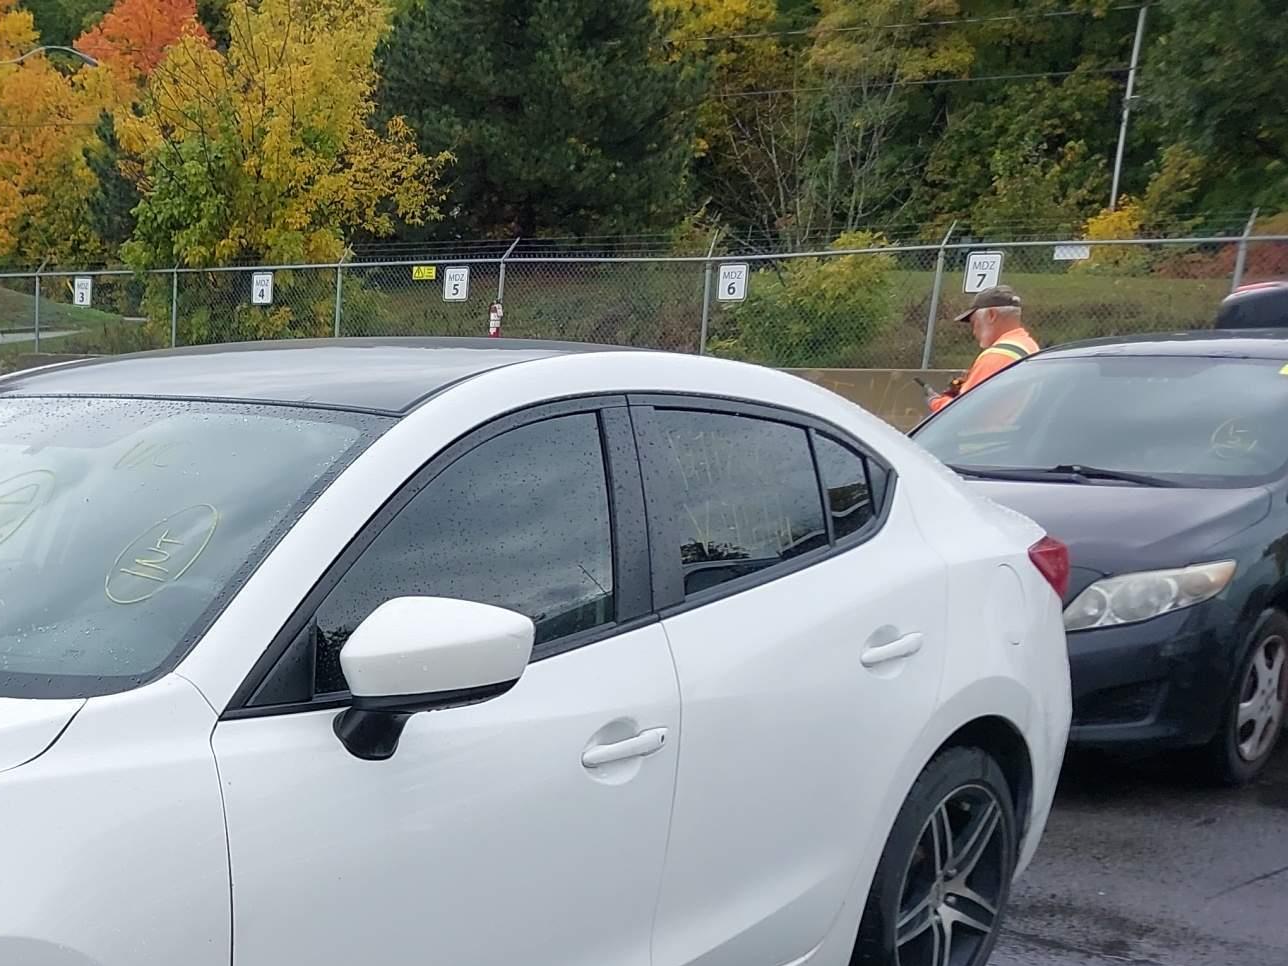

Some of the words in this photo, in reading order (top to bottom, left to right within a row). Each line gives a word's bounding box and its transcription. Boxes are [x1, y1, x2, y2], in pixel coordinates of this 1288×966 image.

[972, 261, 996, 270] MDZ
[723, 271, 742, 279] MDZ
[256, 279, 269, 287] MDZ
[977, 274, 987, 288] 7
[452, 284, 460, 295] 5
[728, 282, 736, 295] 6
[79, 292, 85, 302] 3
[259, 289, 265, 299] 4
